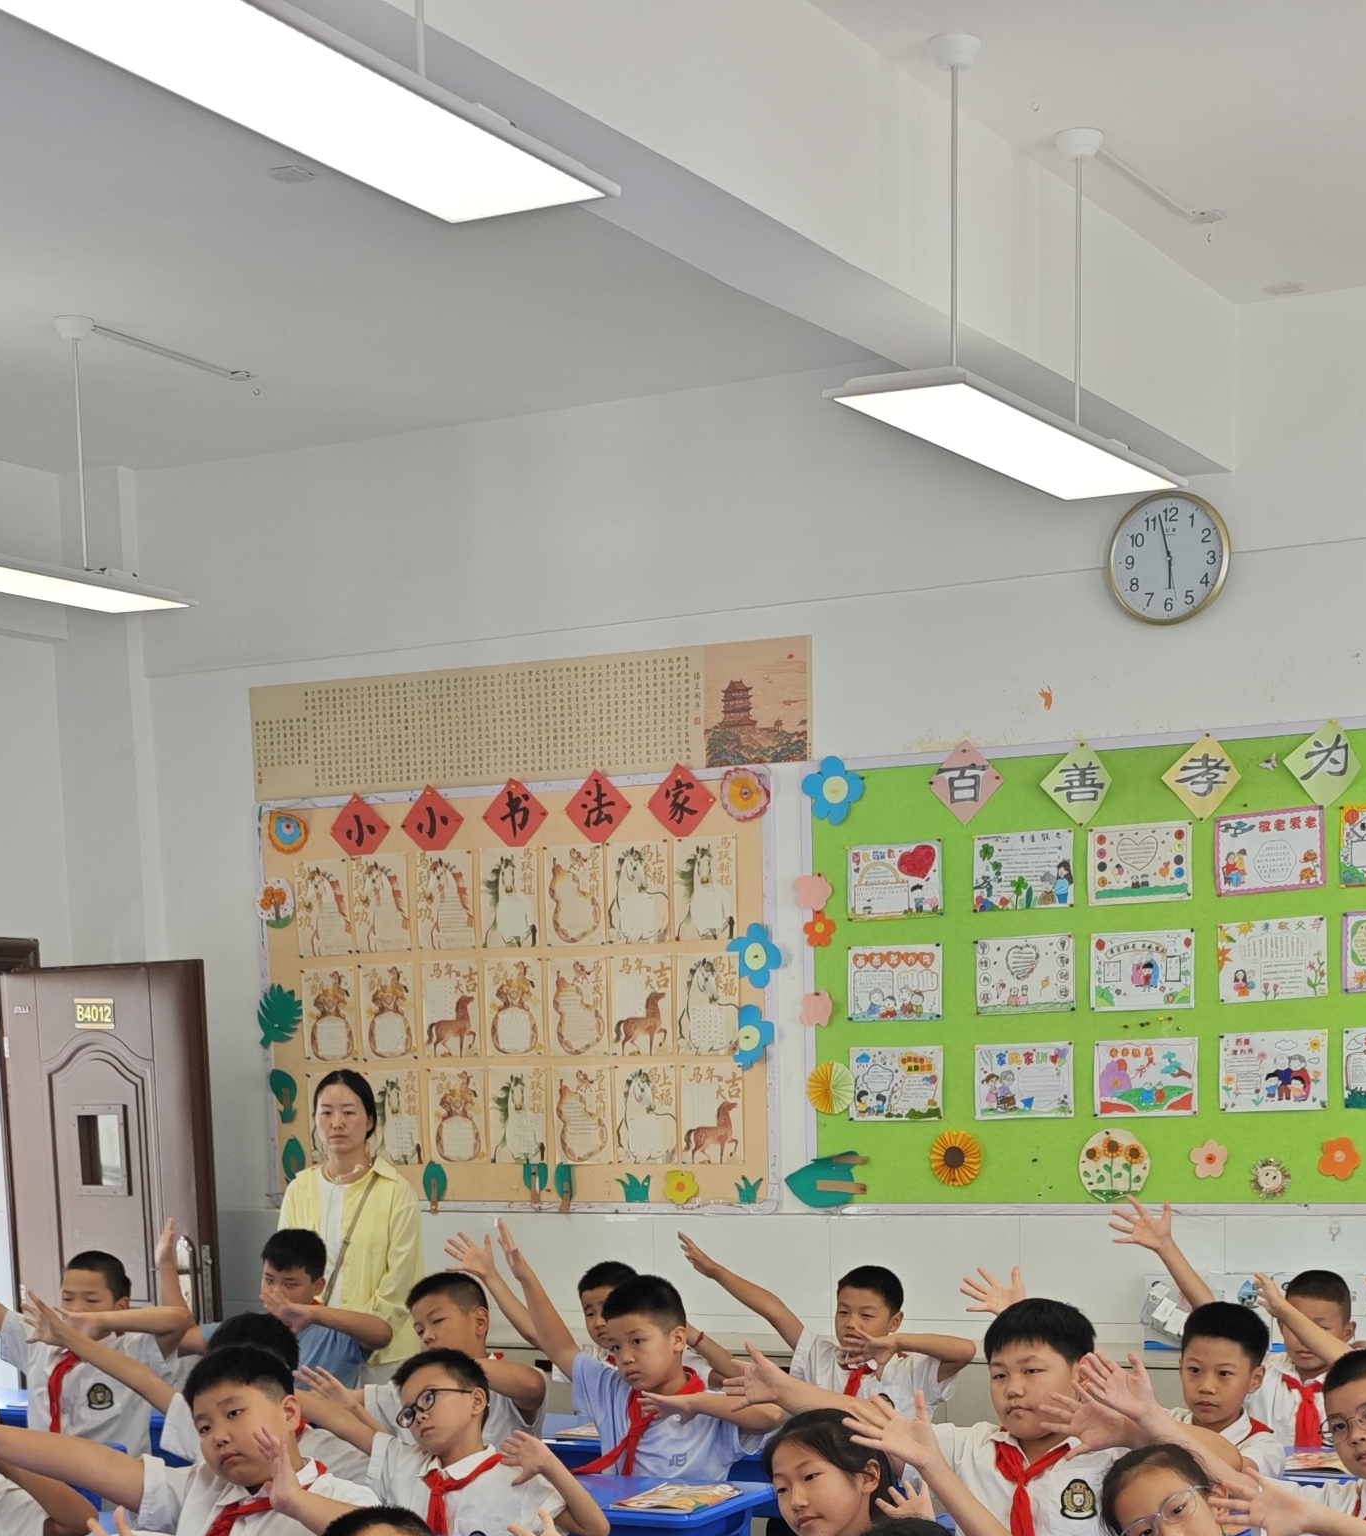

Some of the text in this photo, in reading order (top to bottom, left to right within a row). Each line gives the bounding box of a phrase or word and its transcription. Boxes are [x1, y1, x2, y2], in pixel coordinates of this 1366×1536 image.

[1163, 507, 1178, 522] 12
[1189, 513, 1194, 528] 1
[1144, 517, 1156, 531] 11
[1130, 533, 1144, 547] 10
[1201, 528, 1211, 543] 2
[1125, 555, 1134, 570] 9
[1206, 550, 1216, 565] 3
[1130, 578, 1139, 592] 8
[1200, 572, 1209, 587] 4
[1144, 592, 1154, 607] 7
[1164, 598, 1173, 611] 6
[1184, 590, 1194, 605] 5
[346, 779, 700, 847] 小小书法家
[1258, 815, 1317, 834] 敬老爱老
[1262, 918, 1323, 932] 孝敬父母
[76, 1004, 112, 1022] B4012
[996, 1052, 1048, 1067] 家风家训
